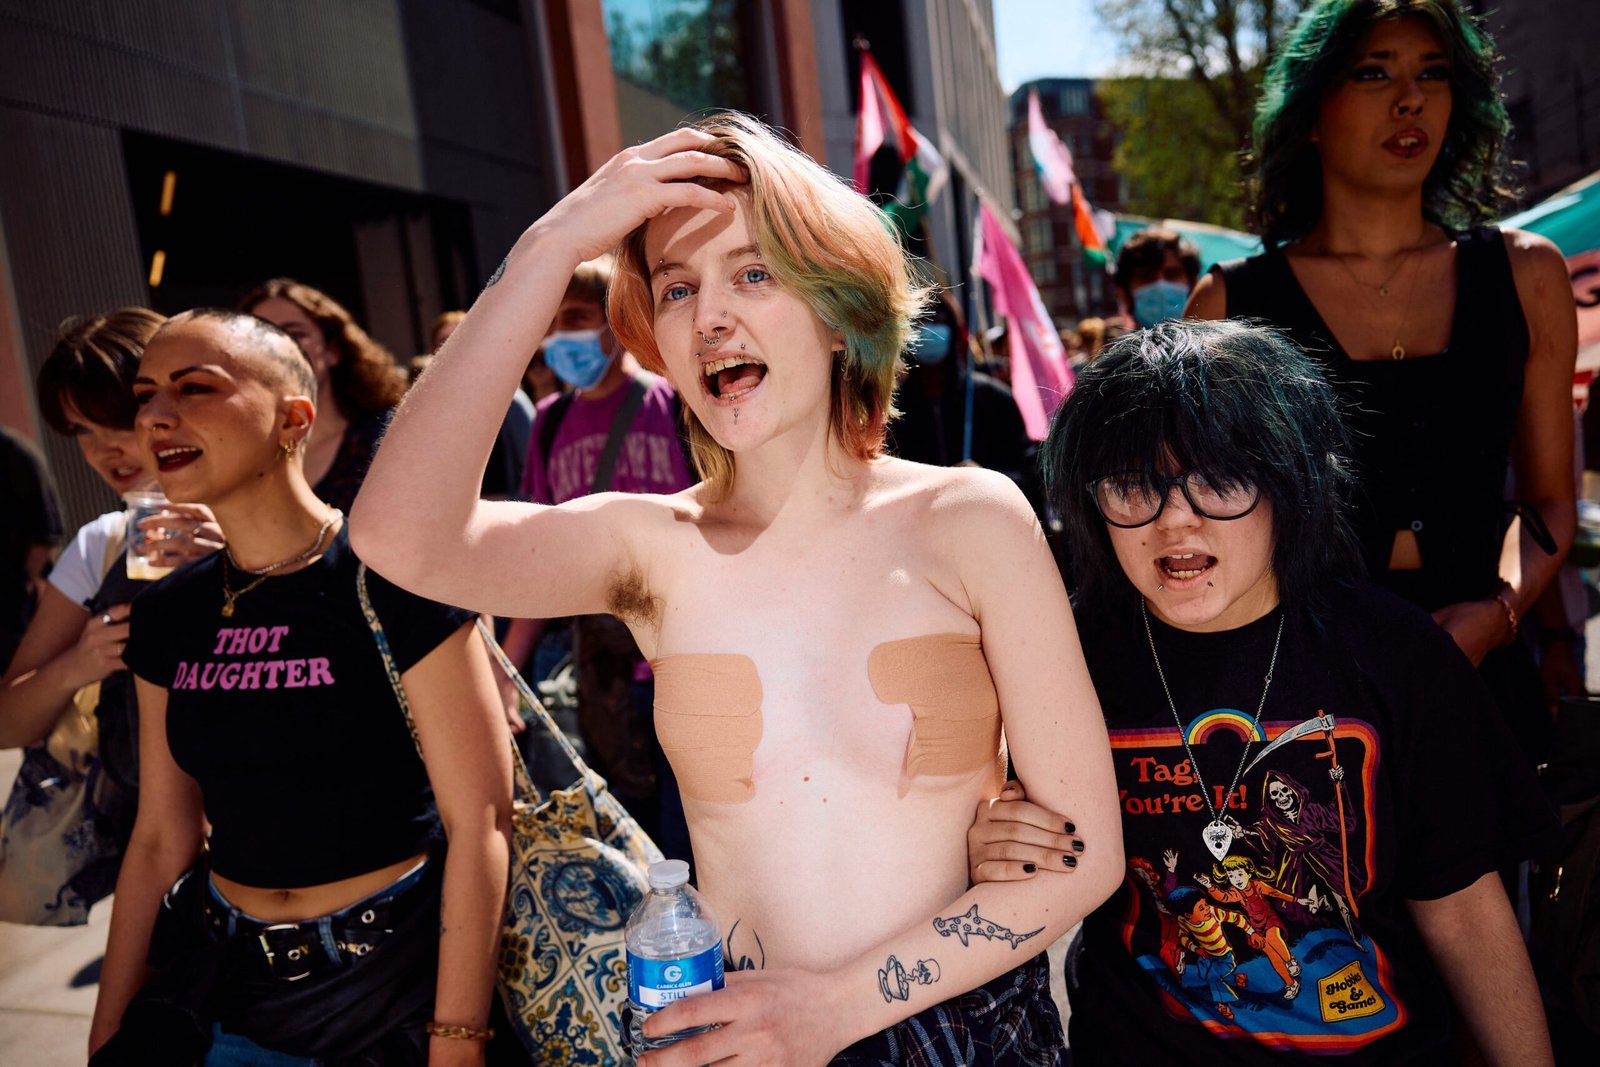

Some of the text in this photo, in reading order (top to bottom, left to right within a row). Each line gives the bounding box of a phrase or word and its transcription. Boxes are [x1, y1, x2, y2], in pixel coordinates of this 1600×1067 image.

[213, 625, 290, 655] THOT
[172, 657, 336, 690] DAUGHTER
[1325, 972, 1363, 996] Hobbies
[1349, 987, 1364, 1001] &
[660, 991, 688, 1000] STILL
[1329, 994, 1377, 1014] Games
